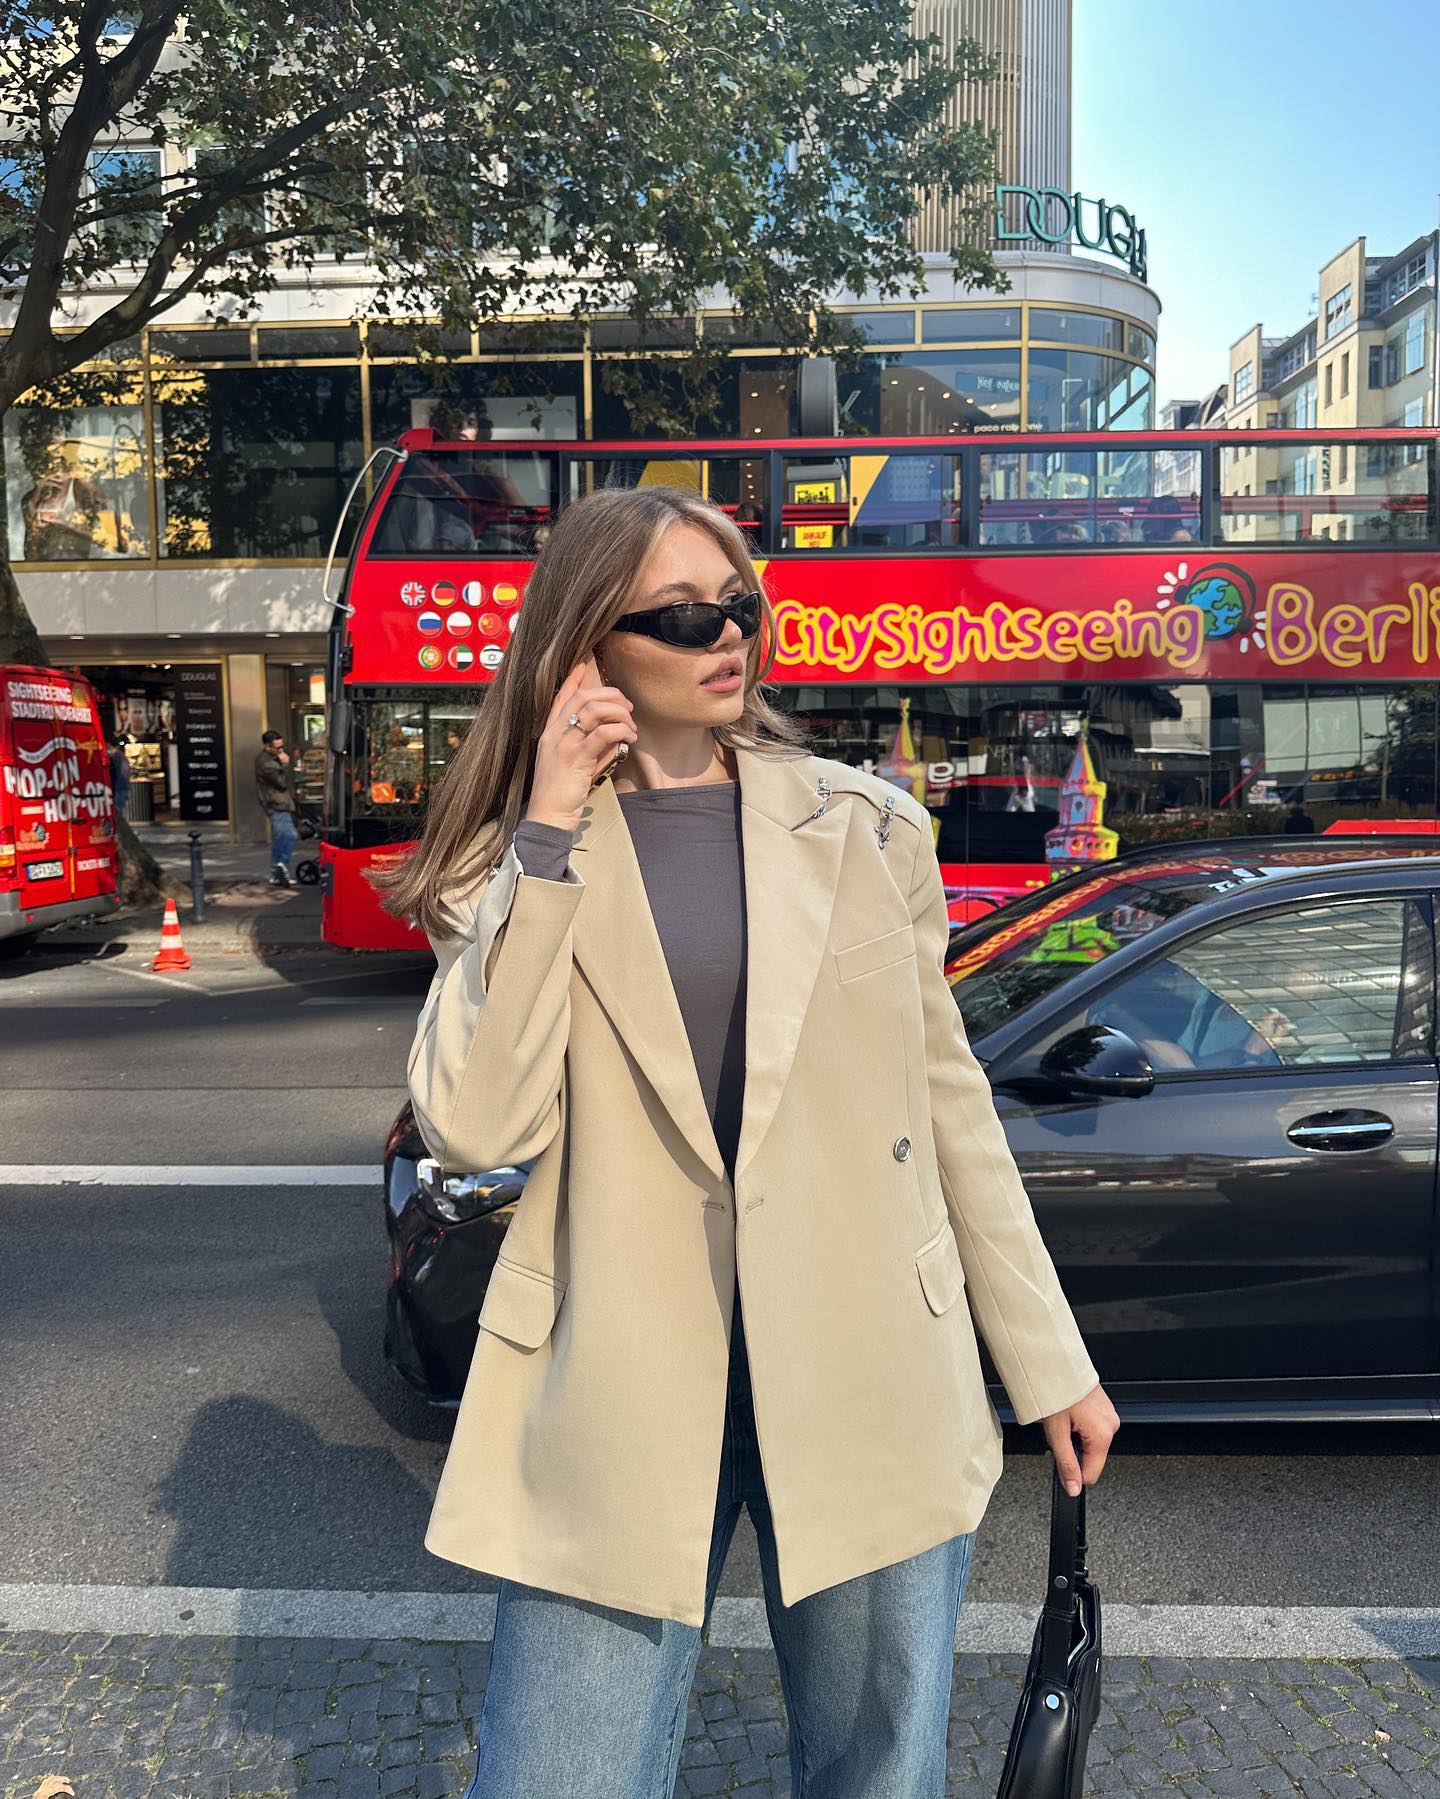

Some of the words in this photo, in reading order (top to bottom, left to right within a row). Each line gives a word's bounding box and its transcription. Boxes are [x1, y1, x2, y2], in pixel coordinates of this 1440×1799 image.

[974, 424, 999, 433] paco
[1001, 423, 1043, 432] rabnne
[7, 681, 72, 703] SIGHTSEEING
[4, 755, 80, 798] HOP-ON
[44, 781, 113, 823] HOP-OFF
